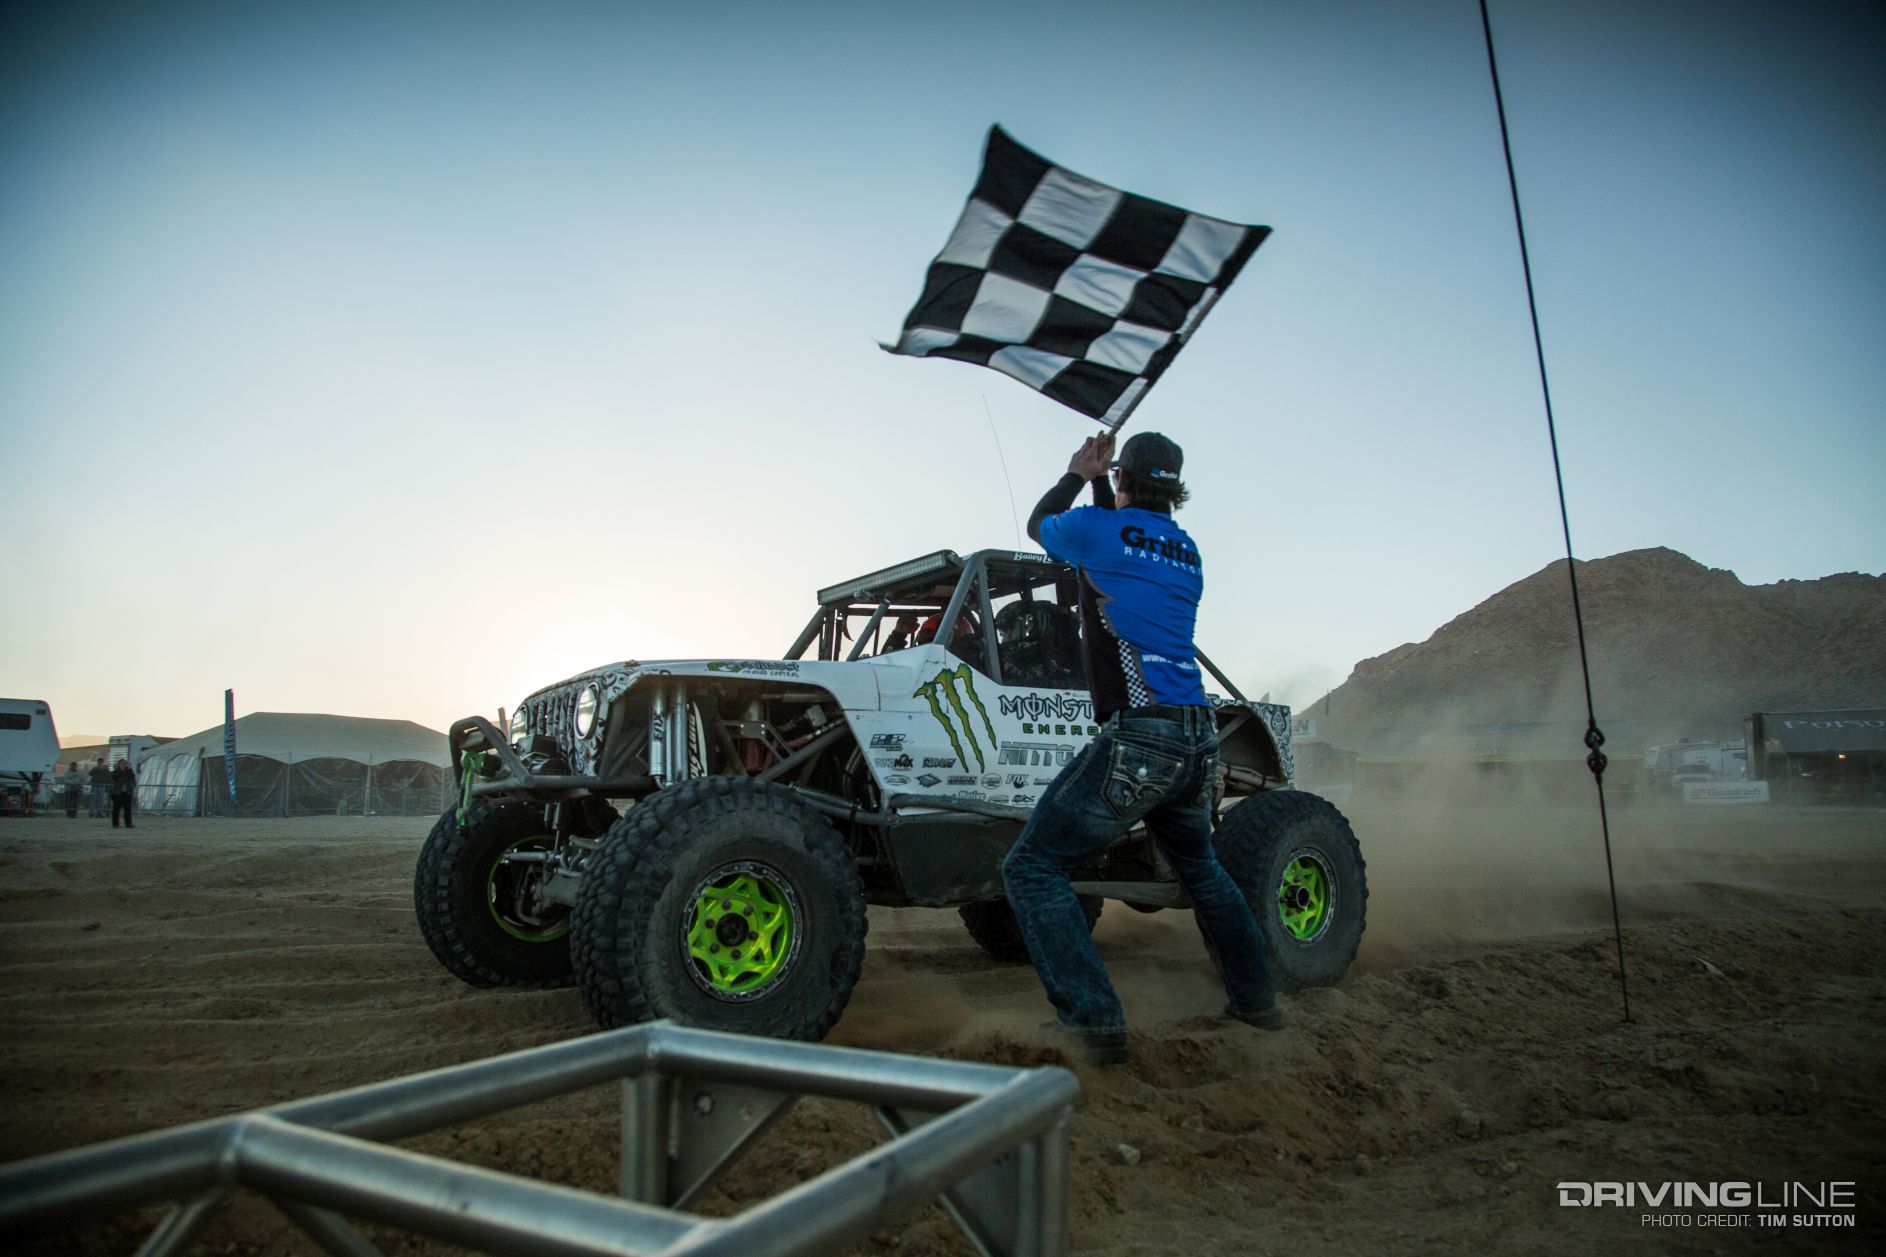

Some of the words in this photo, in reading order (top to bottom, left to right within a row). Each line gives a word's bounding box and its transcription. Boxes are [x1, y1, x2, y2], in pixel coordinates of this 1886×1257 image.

[998, 692, 1093, 722] MONST
[1022, 723, 1100, 736] ENERG
[998, 741, 1076, 767] NITTO
[1005, 773, 1030, 788] FOX
